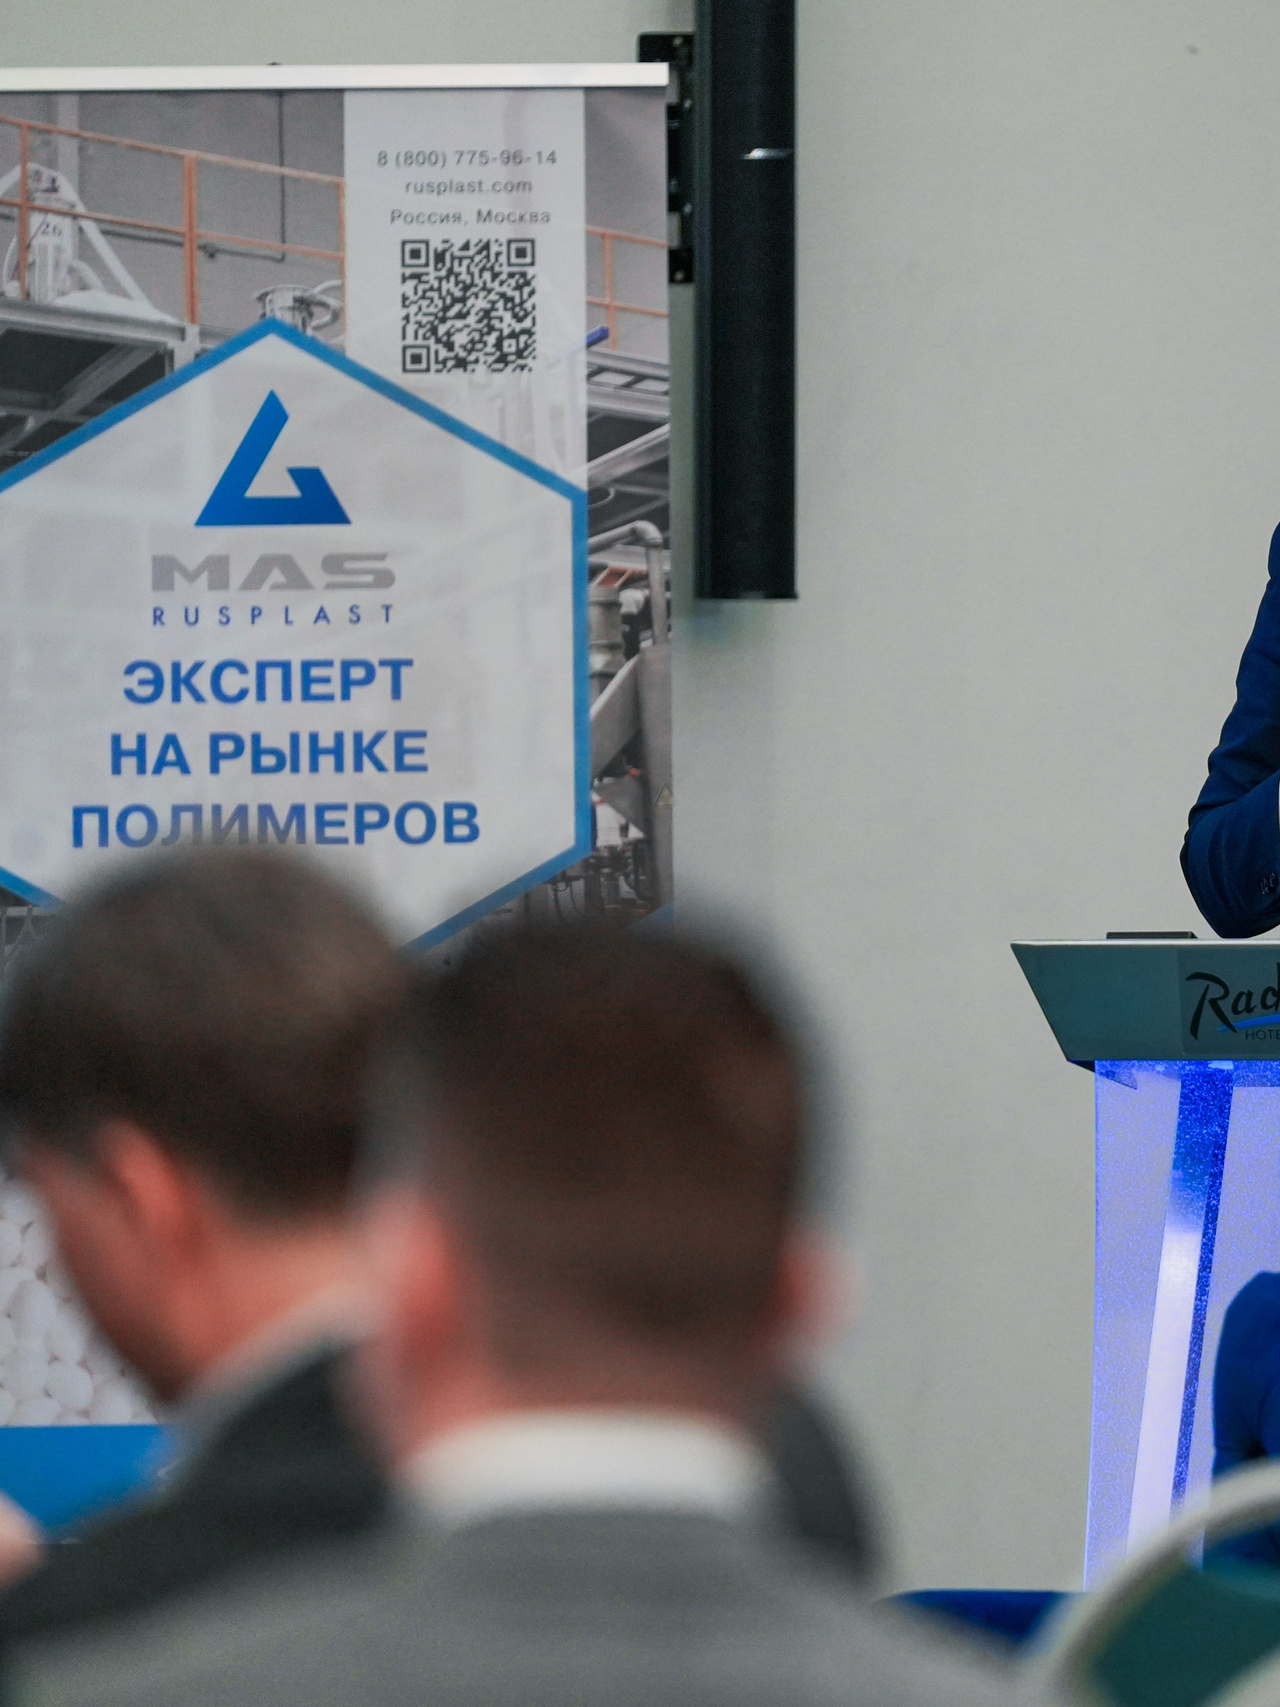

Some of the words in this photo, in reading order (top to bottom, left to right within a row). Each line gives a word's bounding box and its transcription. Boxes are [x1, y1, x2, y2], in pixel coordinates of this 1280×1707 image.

[377, 150, 388, 167] 8
[395, 150, 447, 168] (800)
[455, 149, 557, 166] 775-96-14
[405, 178, 533, 196] rusplast.com
[390, 208, 468, 226] Россия,
[476, 208, 551, 225] Москва
[151, 552, 396, 591] MAS
[153, 604, 394, 625] RUSPLAST
[122, 658, 414, 704] ЭКСПЕРТ
[110, 732, 191, 776] НА
[208, 730, 428, 775] РЫНКЕ
[71, 800, 480, 848] ПОЛИМЕРОВ
